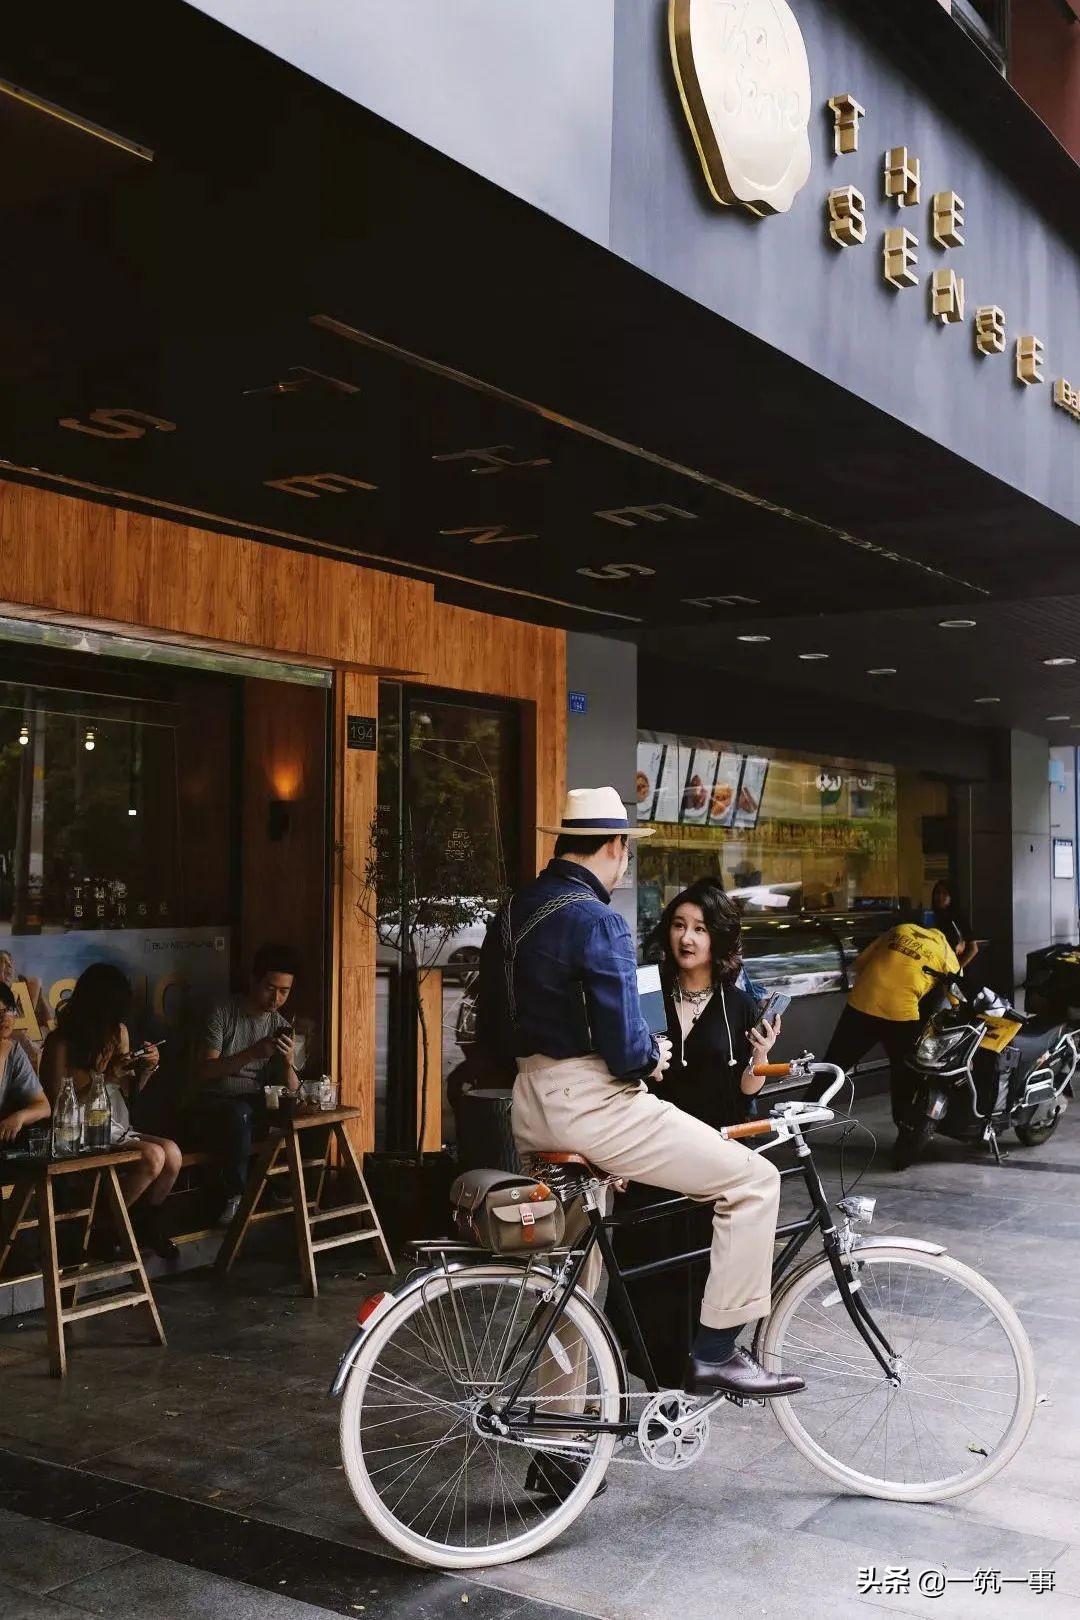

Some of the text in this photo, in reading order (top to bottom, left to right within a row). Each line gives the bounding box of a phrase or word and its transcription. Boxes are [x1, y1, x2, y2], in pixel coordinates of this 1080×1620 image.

[828, 94, 965, 249] THE
[828, 185, 1045, 385] SENSE
[1054, 377, 1080, 420] Ba
[351, 725, 373, 740] 194
[73, 902, 168, 918] SENSE
